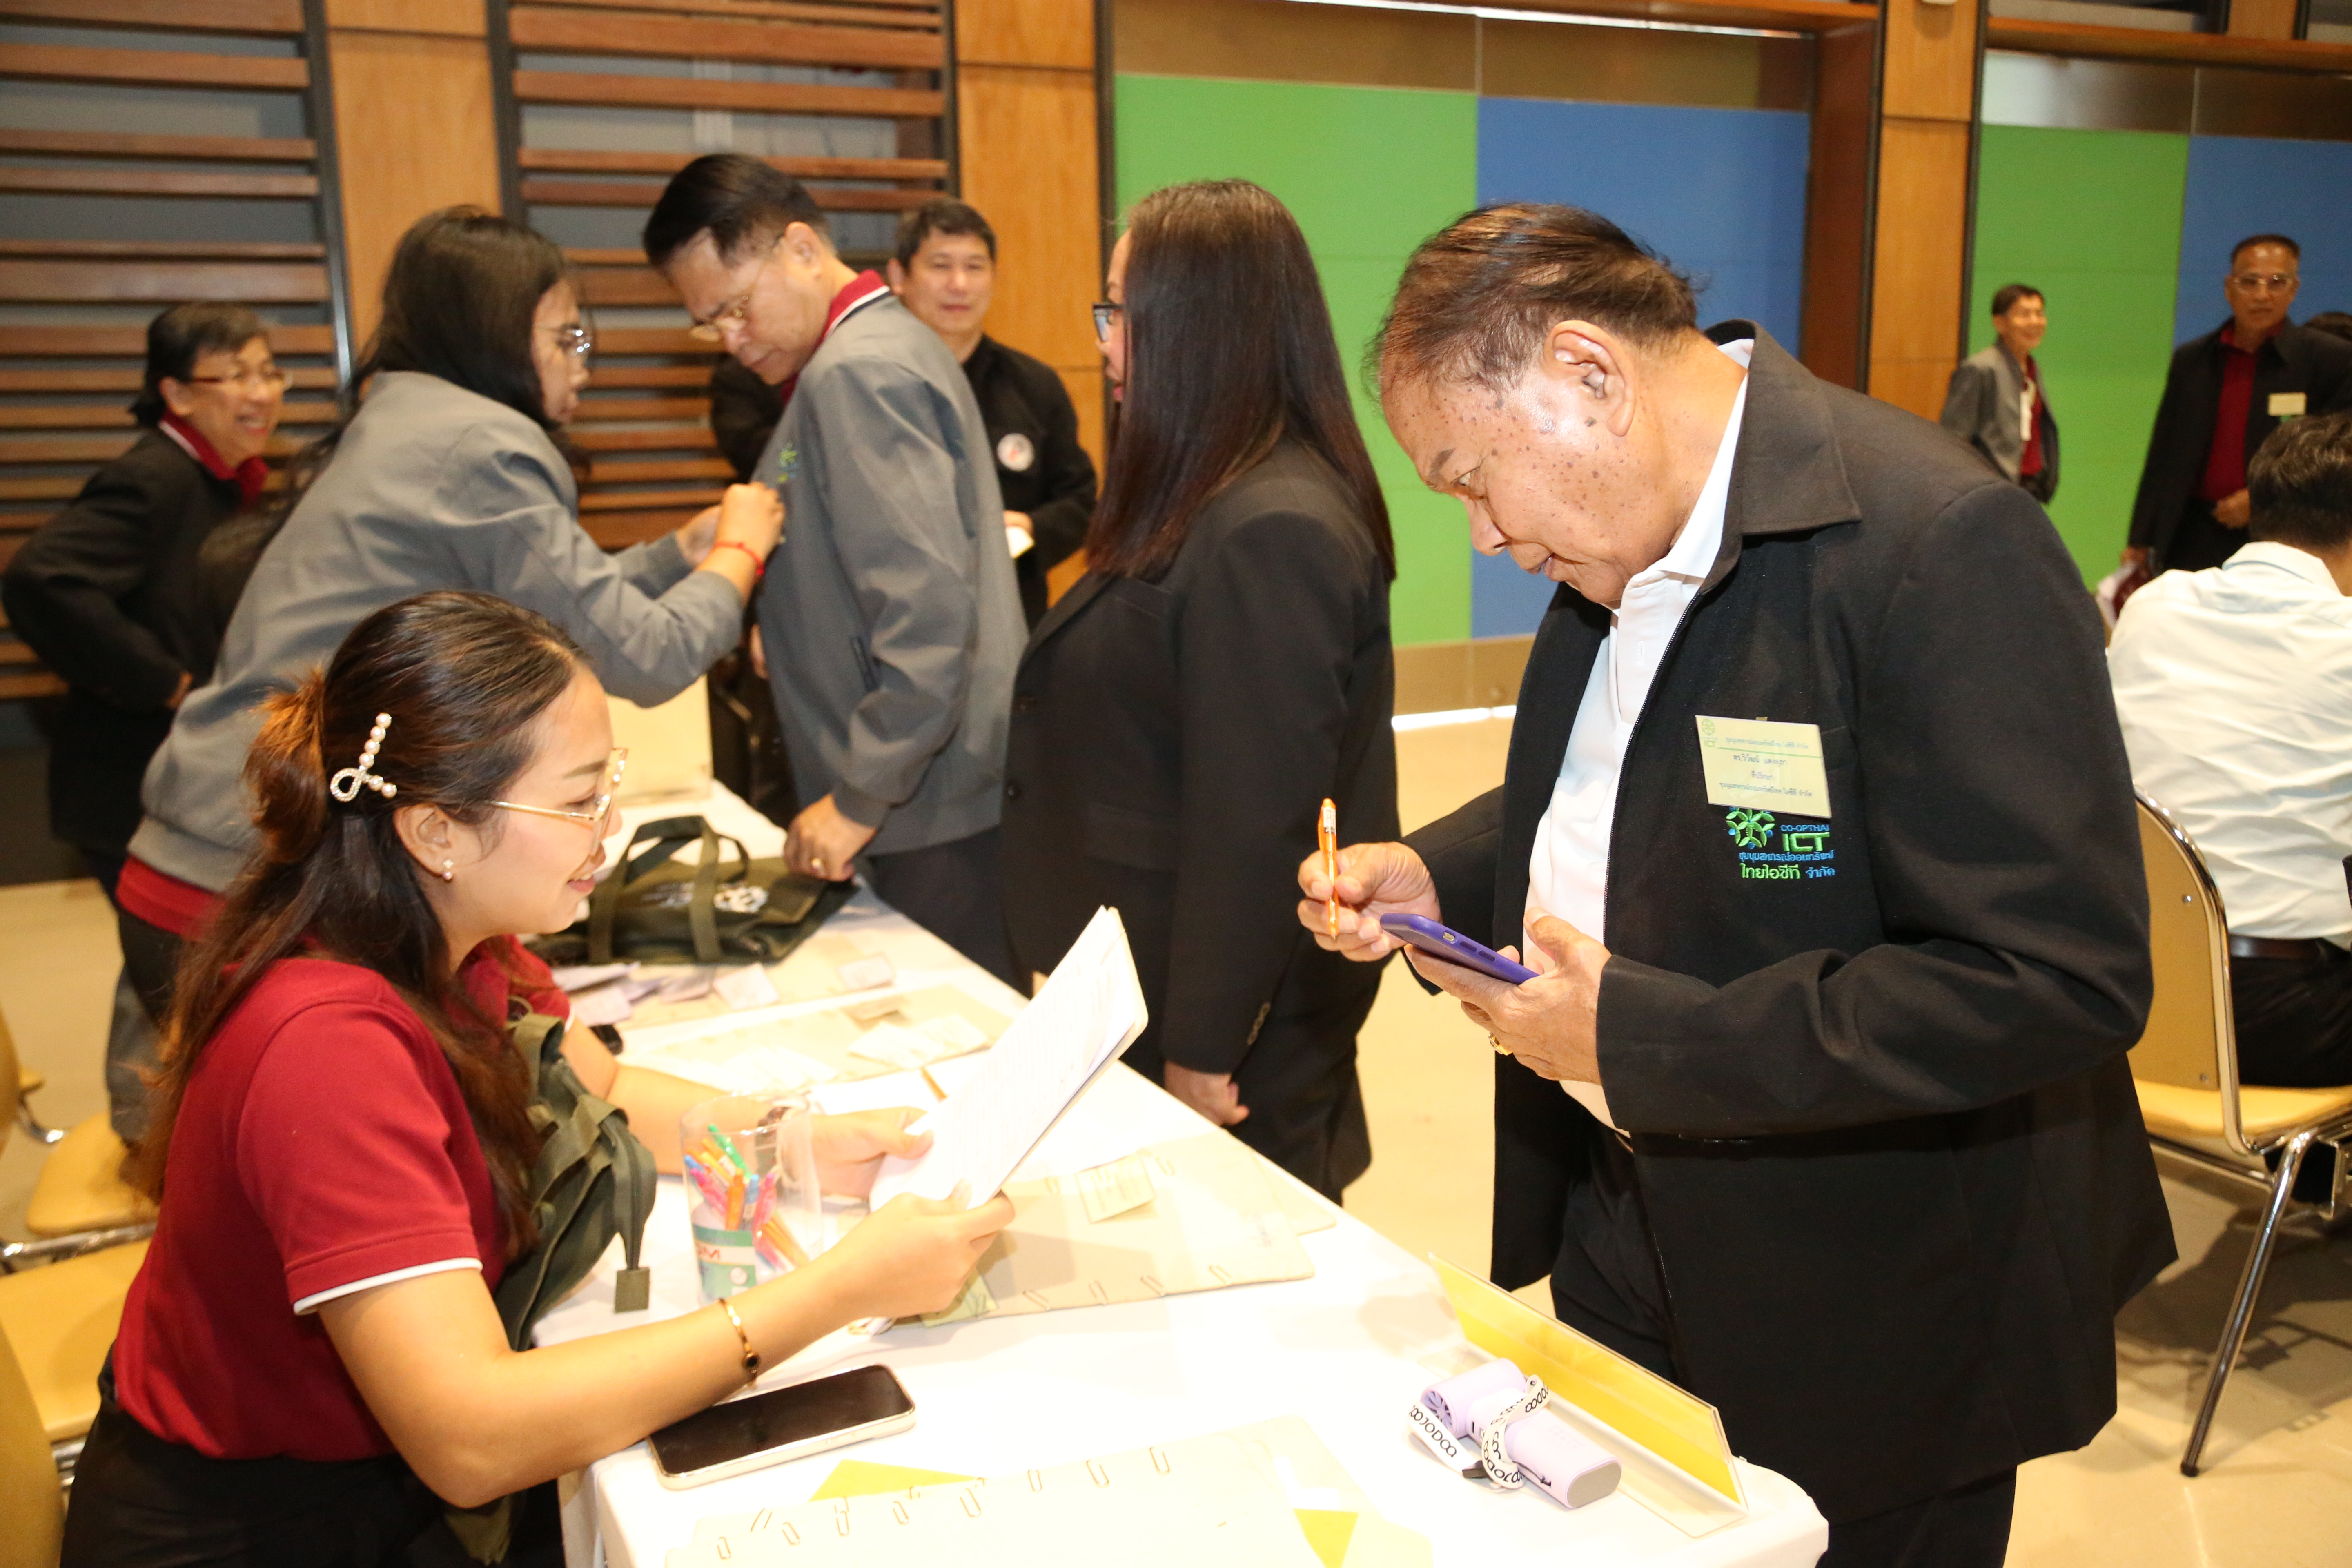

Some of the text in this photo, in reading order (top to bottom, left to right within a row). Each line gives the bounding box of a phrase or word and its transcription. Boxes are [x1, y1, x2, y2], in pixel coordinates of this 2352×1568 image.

[1782, 832, 1830, 852] ICT
[1739, 850, 1835, 863] ชุมนุมสหกรณ์ออมทรัพย์
[1740, 863, 1836, 879] ไทยไอซีที จำกัด
